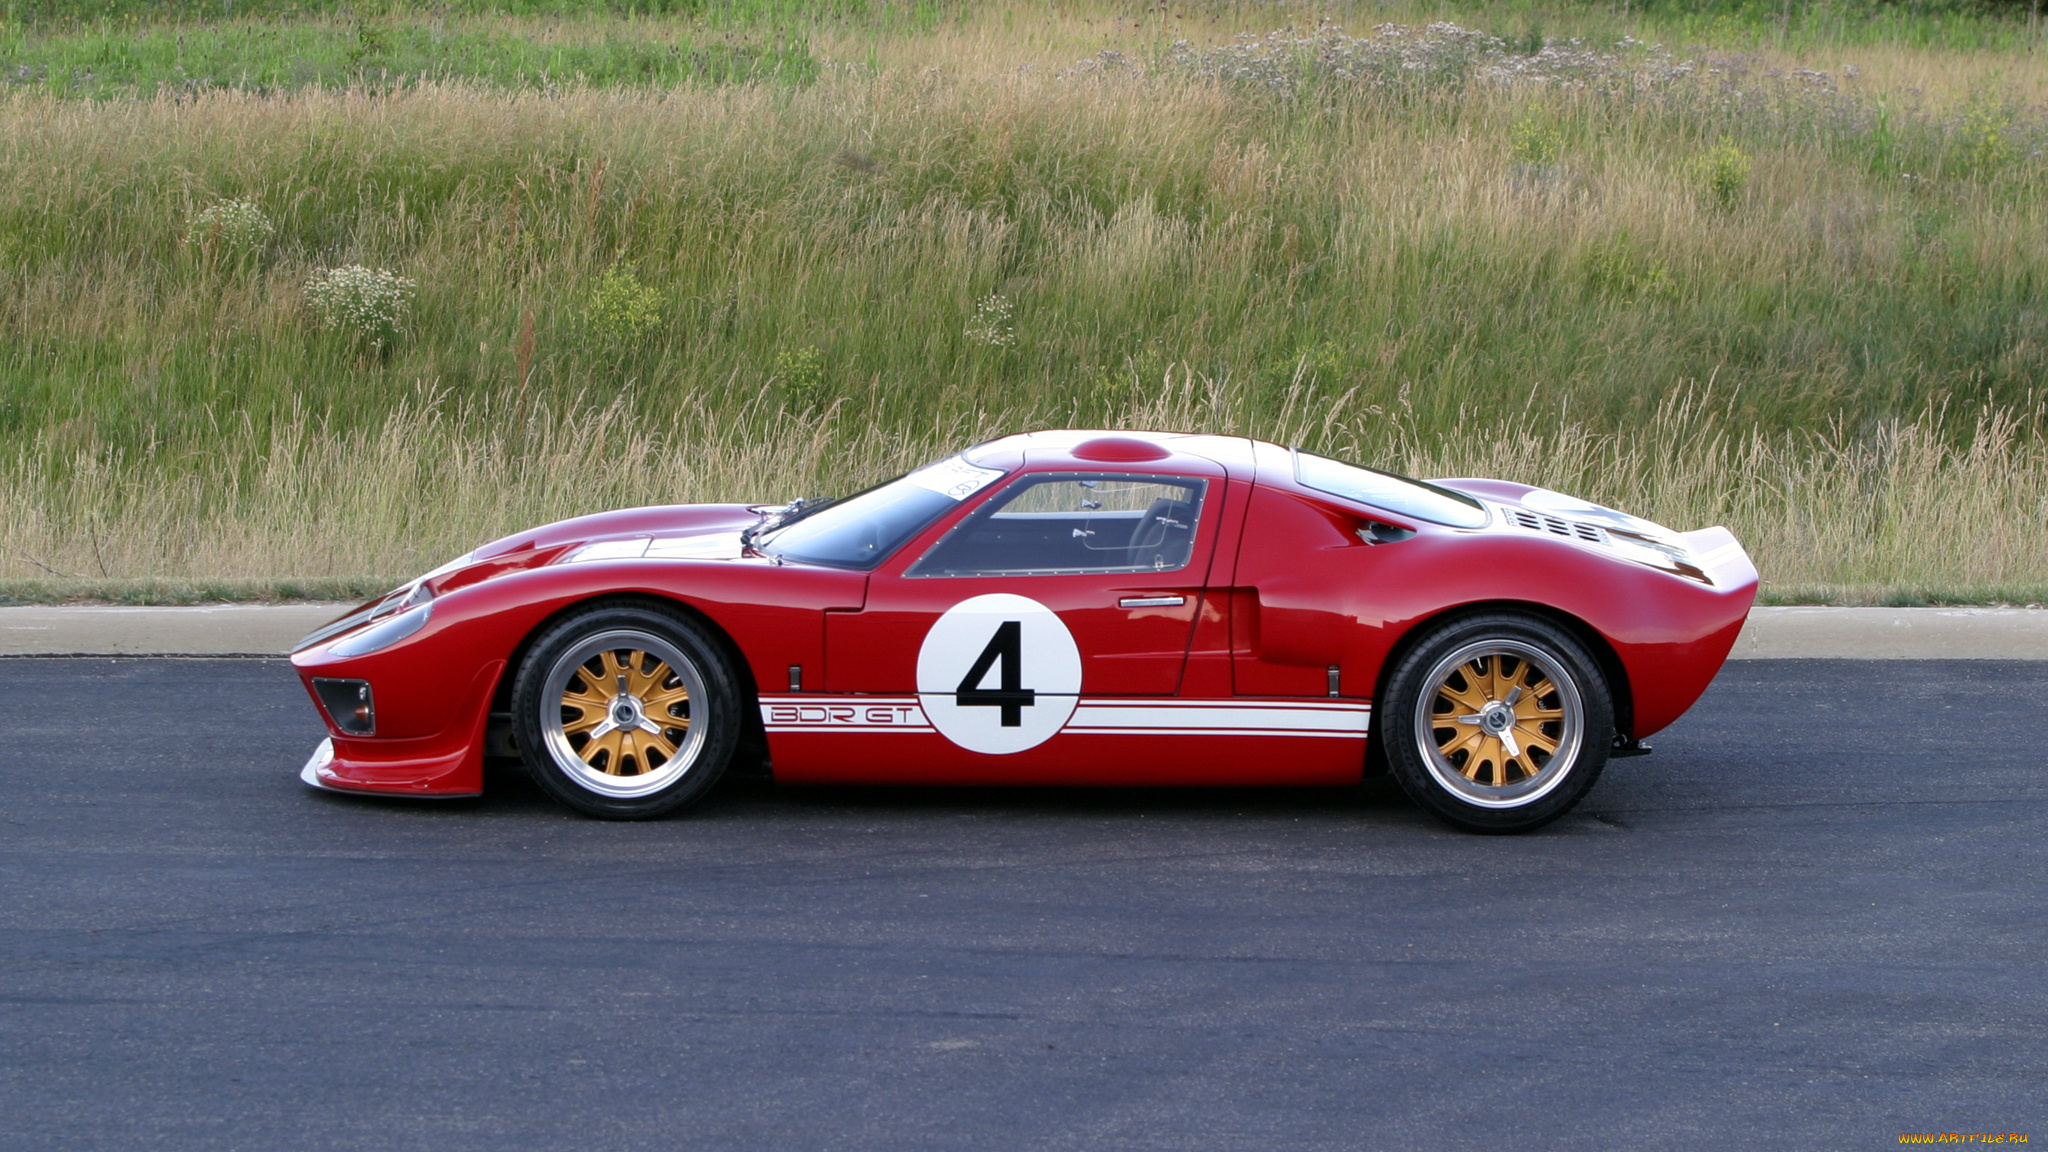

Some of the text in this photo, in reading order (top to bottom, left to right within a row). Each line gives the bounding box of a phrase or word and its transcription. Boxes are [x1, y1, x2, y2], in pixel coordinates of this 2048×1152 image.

[956, 621, 1035, 727] 4
[771, 706, 914, 723] BDR GT
